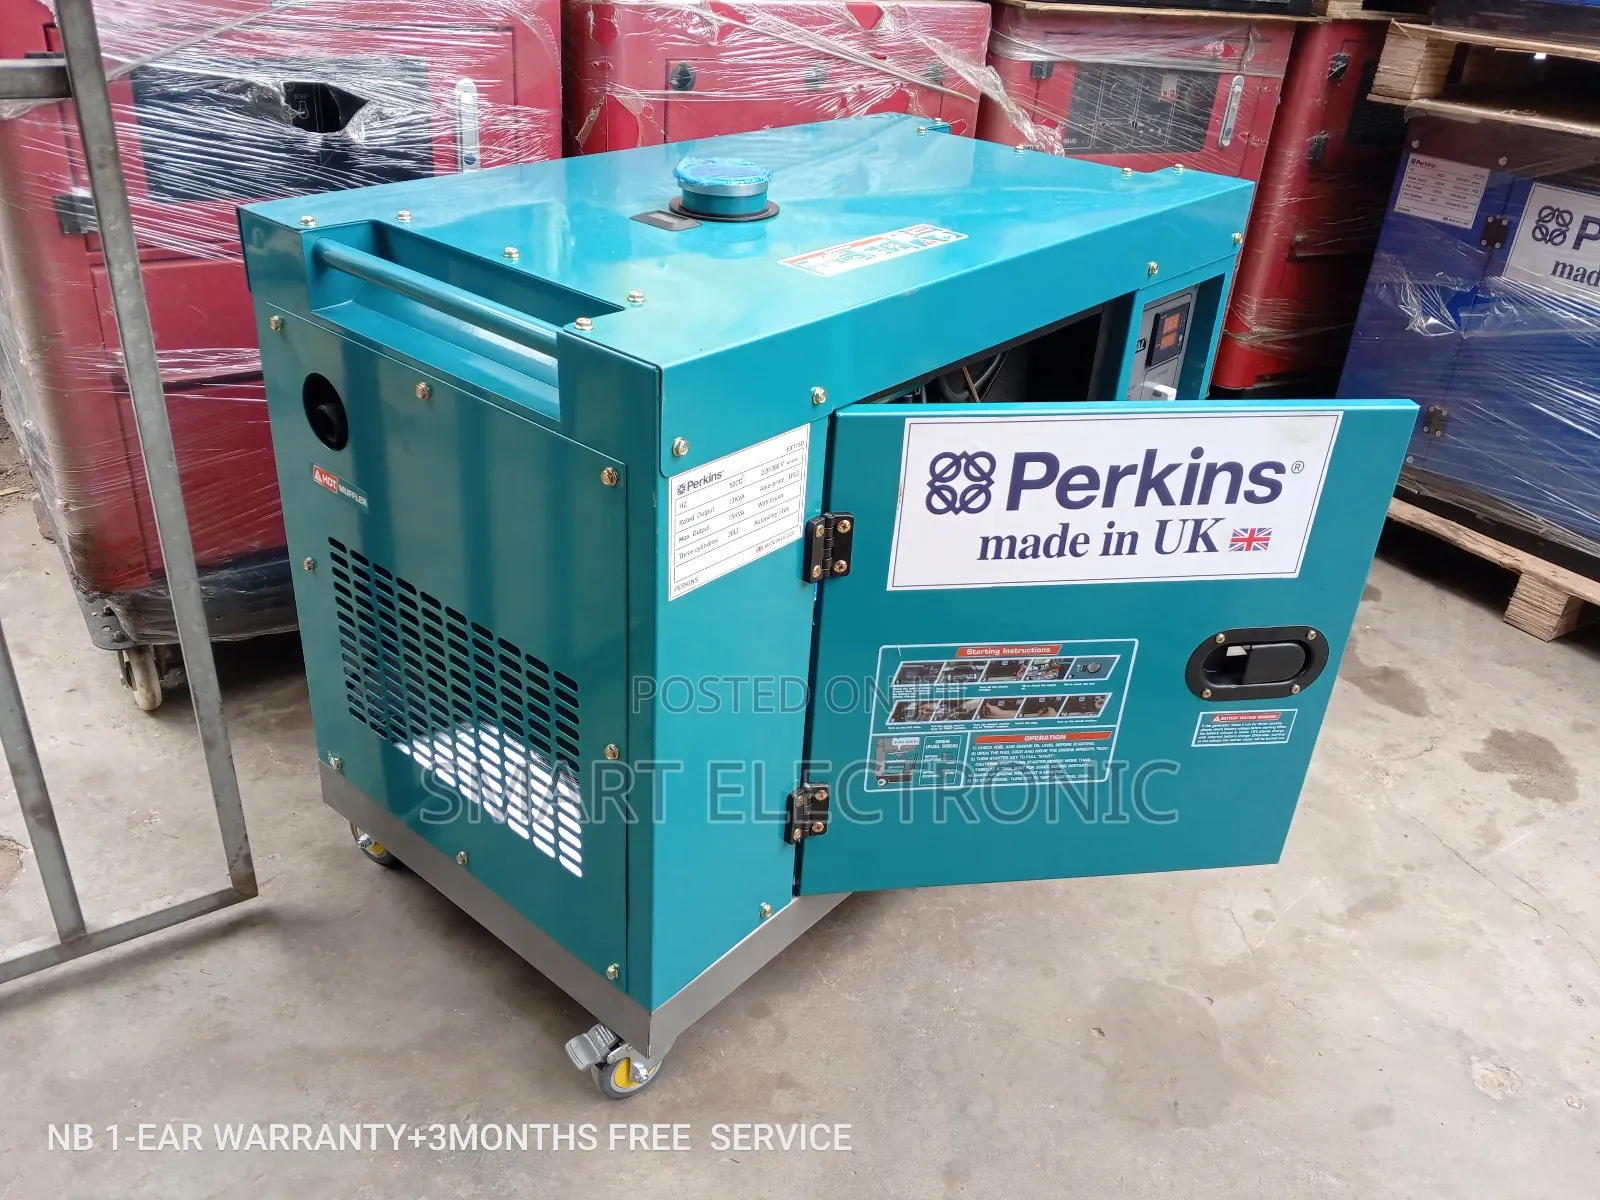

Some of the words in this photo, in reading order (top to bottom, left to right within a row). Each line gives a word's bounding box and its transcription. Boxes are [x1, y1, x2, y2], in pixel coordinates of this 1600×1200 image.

[687, 470, 723, 491] Perkins
[1006, 446, 1286, 511] Perkins
[322, 474, 336, 489] HOT
[339, 484, 367, 506] MUFFLER
[678, 514, 695, 526] Rated
[697, 506, 715, 519] Output
[678, 533, 690, 543] Max
[692, 525, 710, 537] Output
[976, 522, 1090, 561] made
[1100, 521, 1139, 557] in
[1154, 517, 1226, 554] UK
[679, 549, 694, 560] Three
[673, 576, 699, 592] PERKINS
[967, 648, 1000, 656] Starting
